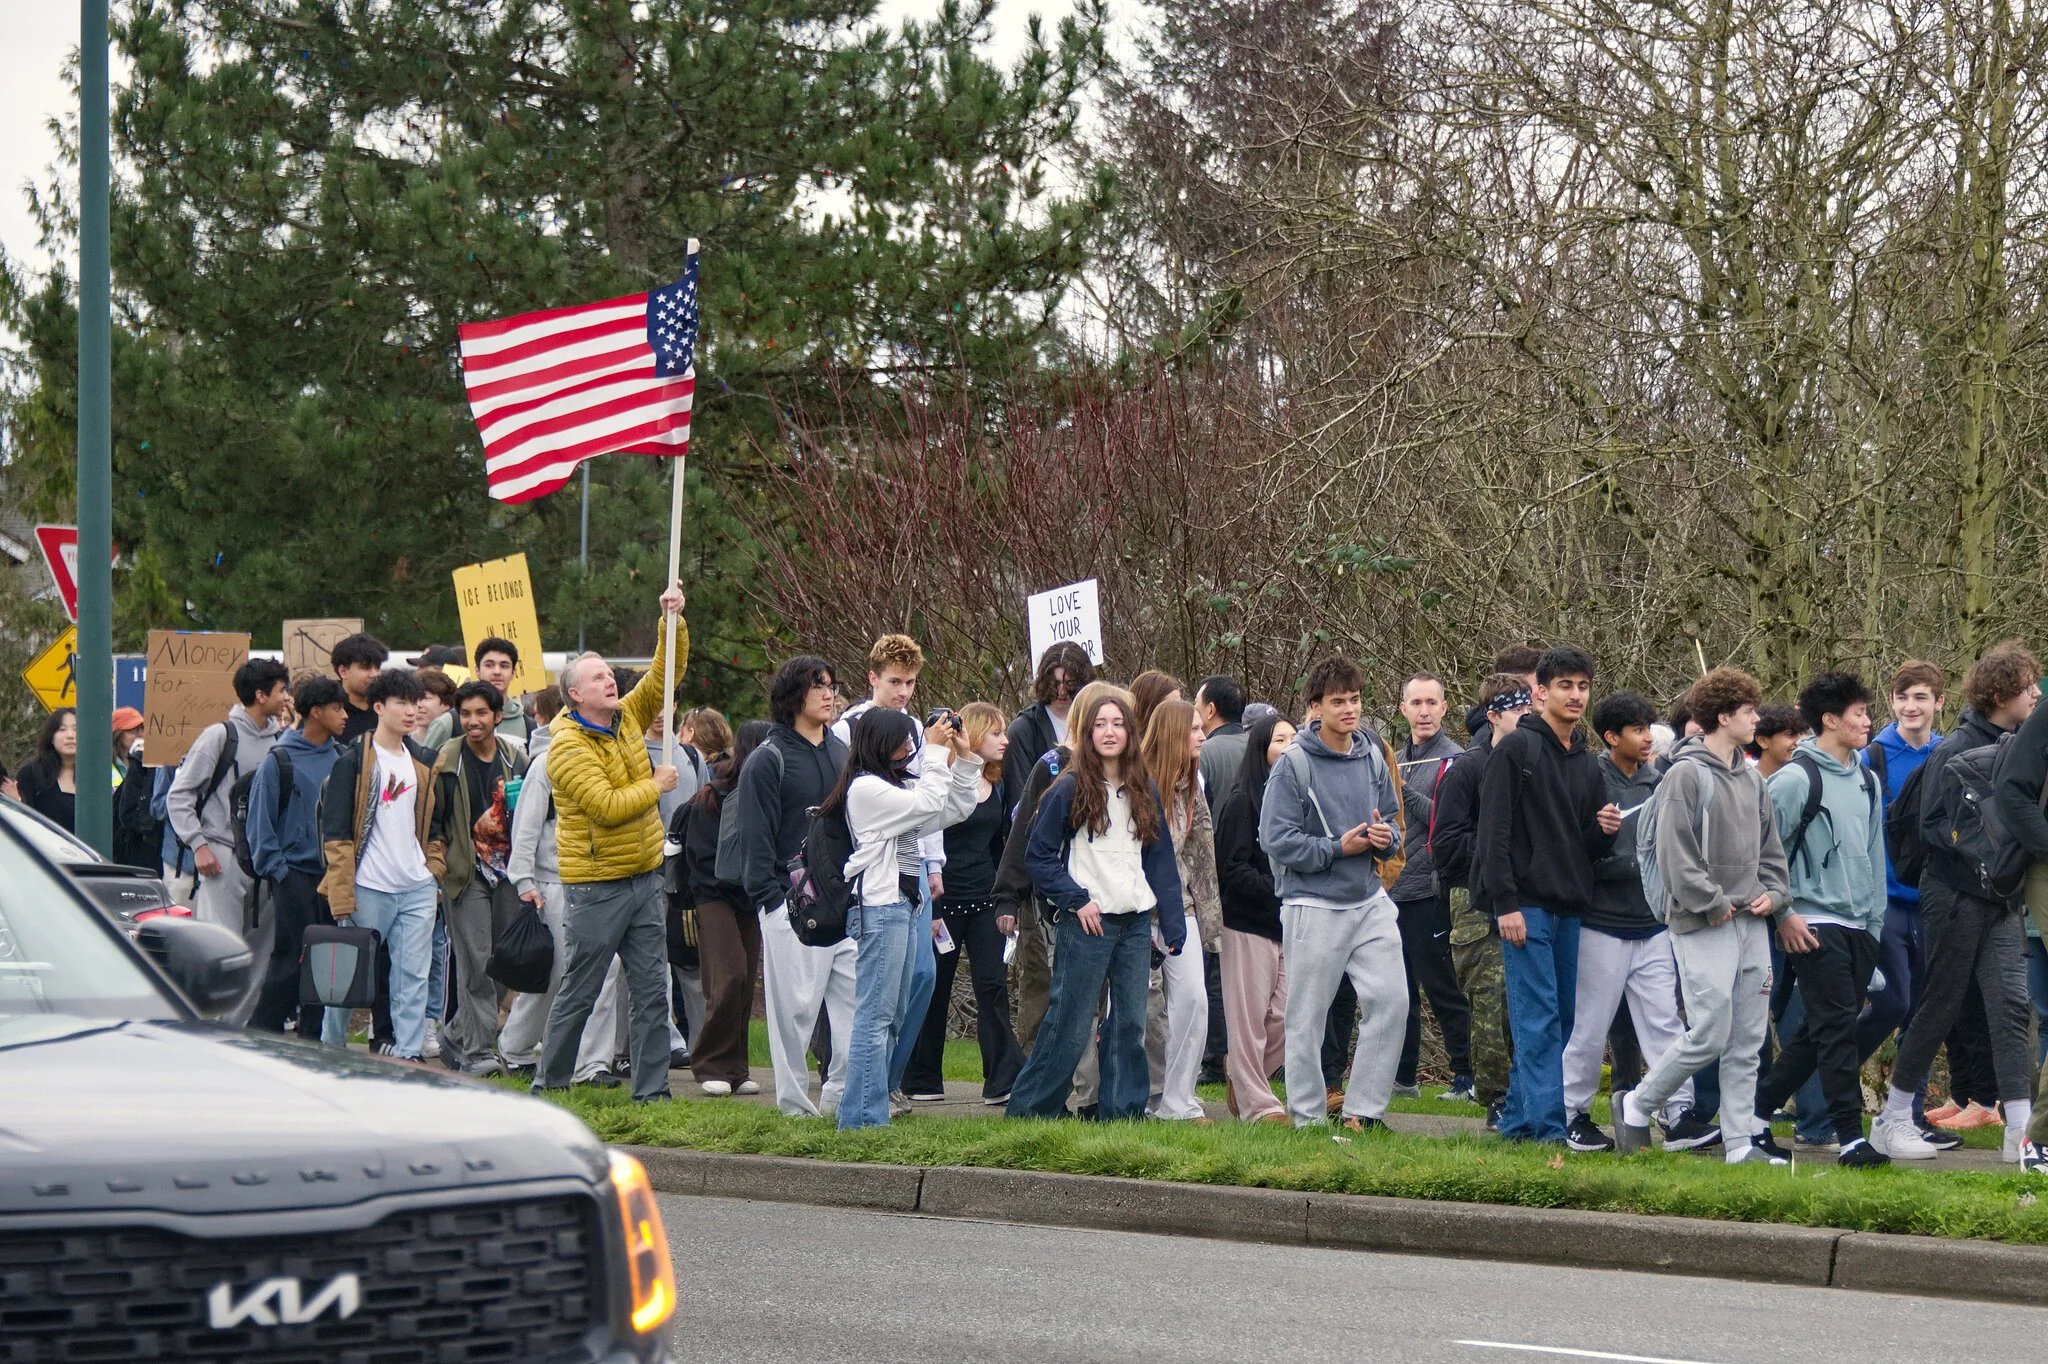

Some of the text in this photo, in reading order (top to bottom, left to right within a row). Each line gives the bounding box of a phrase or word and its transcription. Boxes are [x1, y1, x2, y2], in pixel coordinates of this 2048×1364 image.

[463, 580, 524, 607] ICE BELONGS
[1050, 591, 1081, 616] LOVE
[486, 621, 517, 639] IN THE
[1050, 617, 1081, 641] YOUR
[152, 637, 244, 672] Money
[152, 671, 190, 693] For
[148, 713, 192, 738] Not
[121, 891, 136, 901] SR
[208, 1272, 360, 1329] KIA
